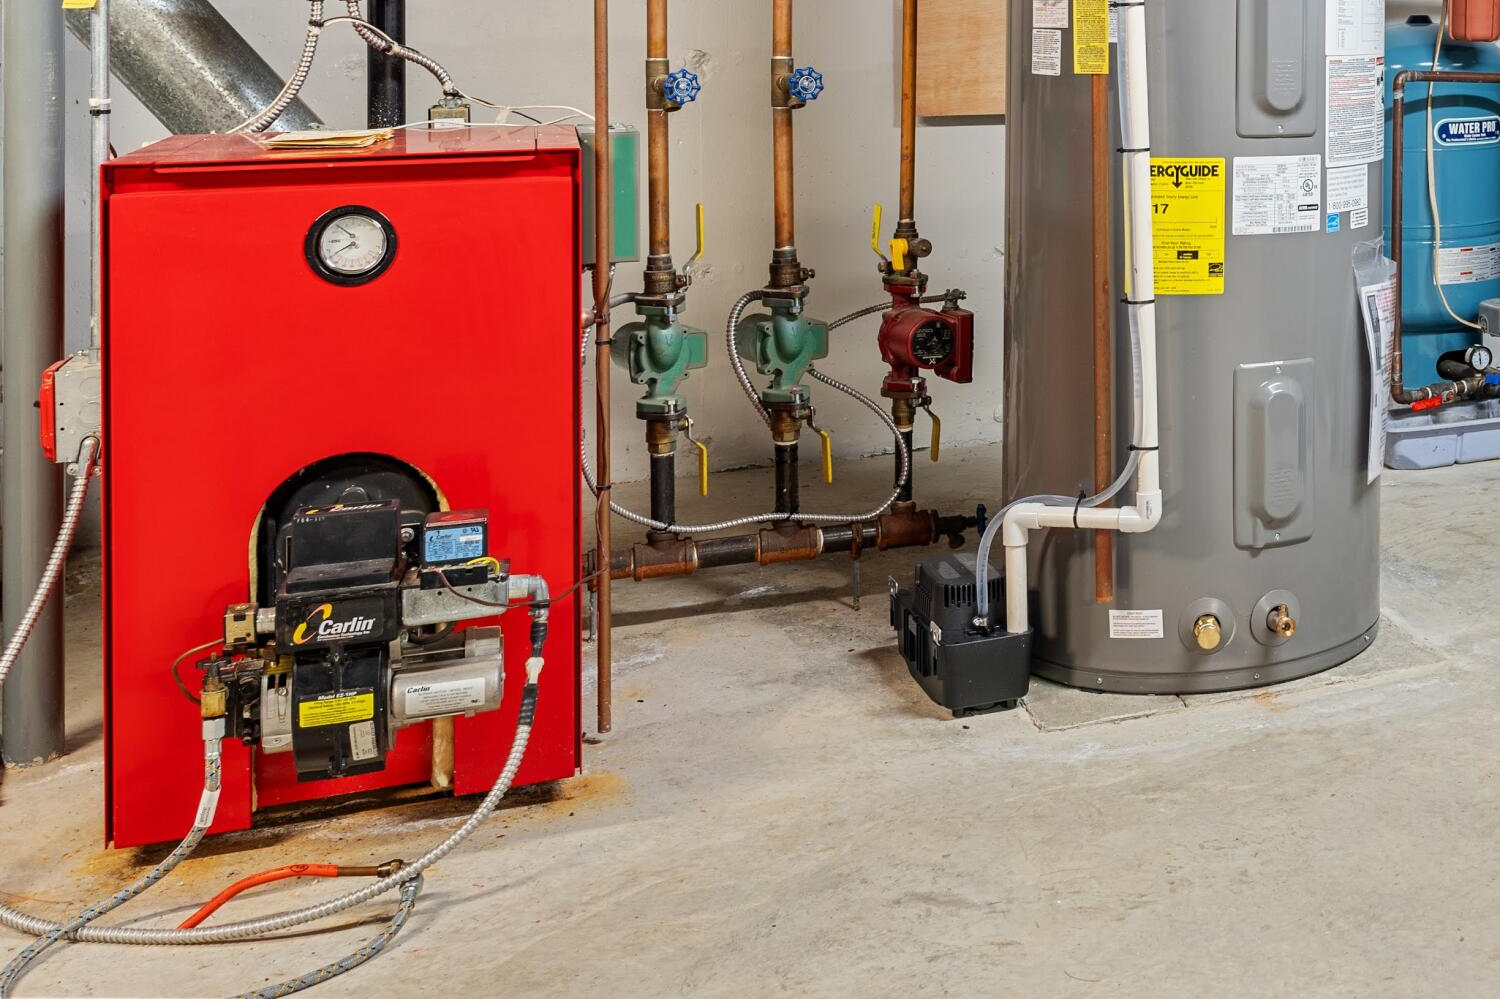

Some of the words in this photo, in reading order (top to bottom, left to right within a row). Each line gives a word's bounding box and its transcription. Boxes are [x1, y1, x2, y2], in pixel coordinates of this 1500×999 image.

[1448, 122, 1481, 135] WATER
[1482, 121, 1496, 133] PRO
[1150, 165, 1219, 179] ERGYGUIDE
[1152, 203, 1169, 214] 17
[318, 616, 374, 635] Carlin
